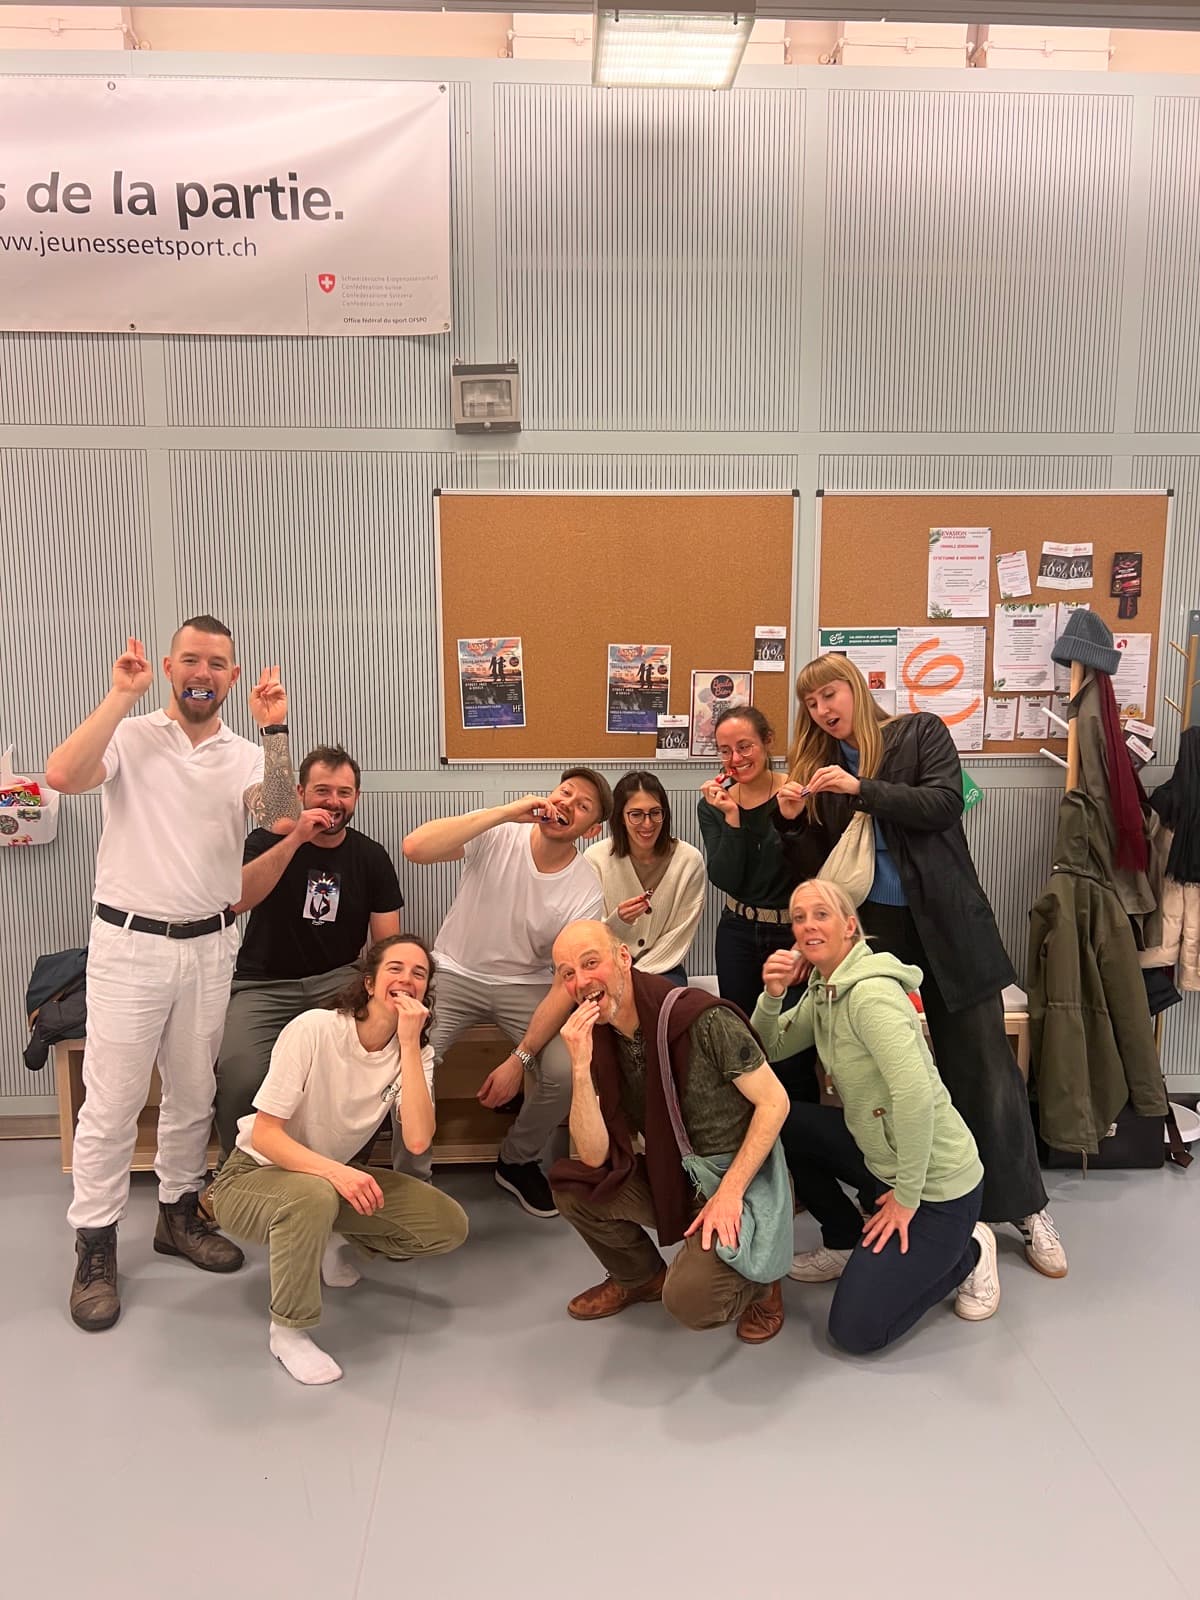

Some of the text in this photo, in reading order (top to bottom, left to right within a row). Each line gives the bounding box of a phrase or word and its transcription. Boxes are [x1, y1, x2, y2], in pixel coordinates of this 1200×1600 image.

[26, 171, 92, 214] de
[113, 170, 157, 215] la
[175, 172, 344, 230] partie.
